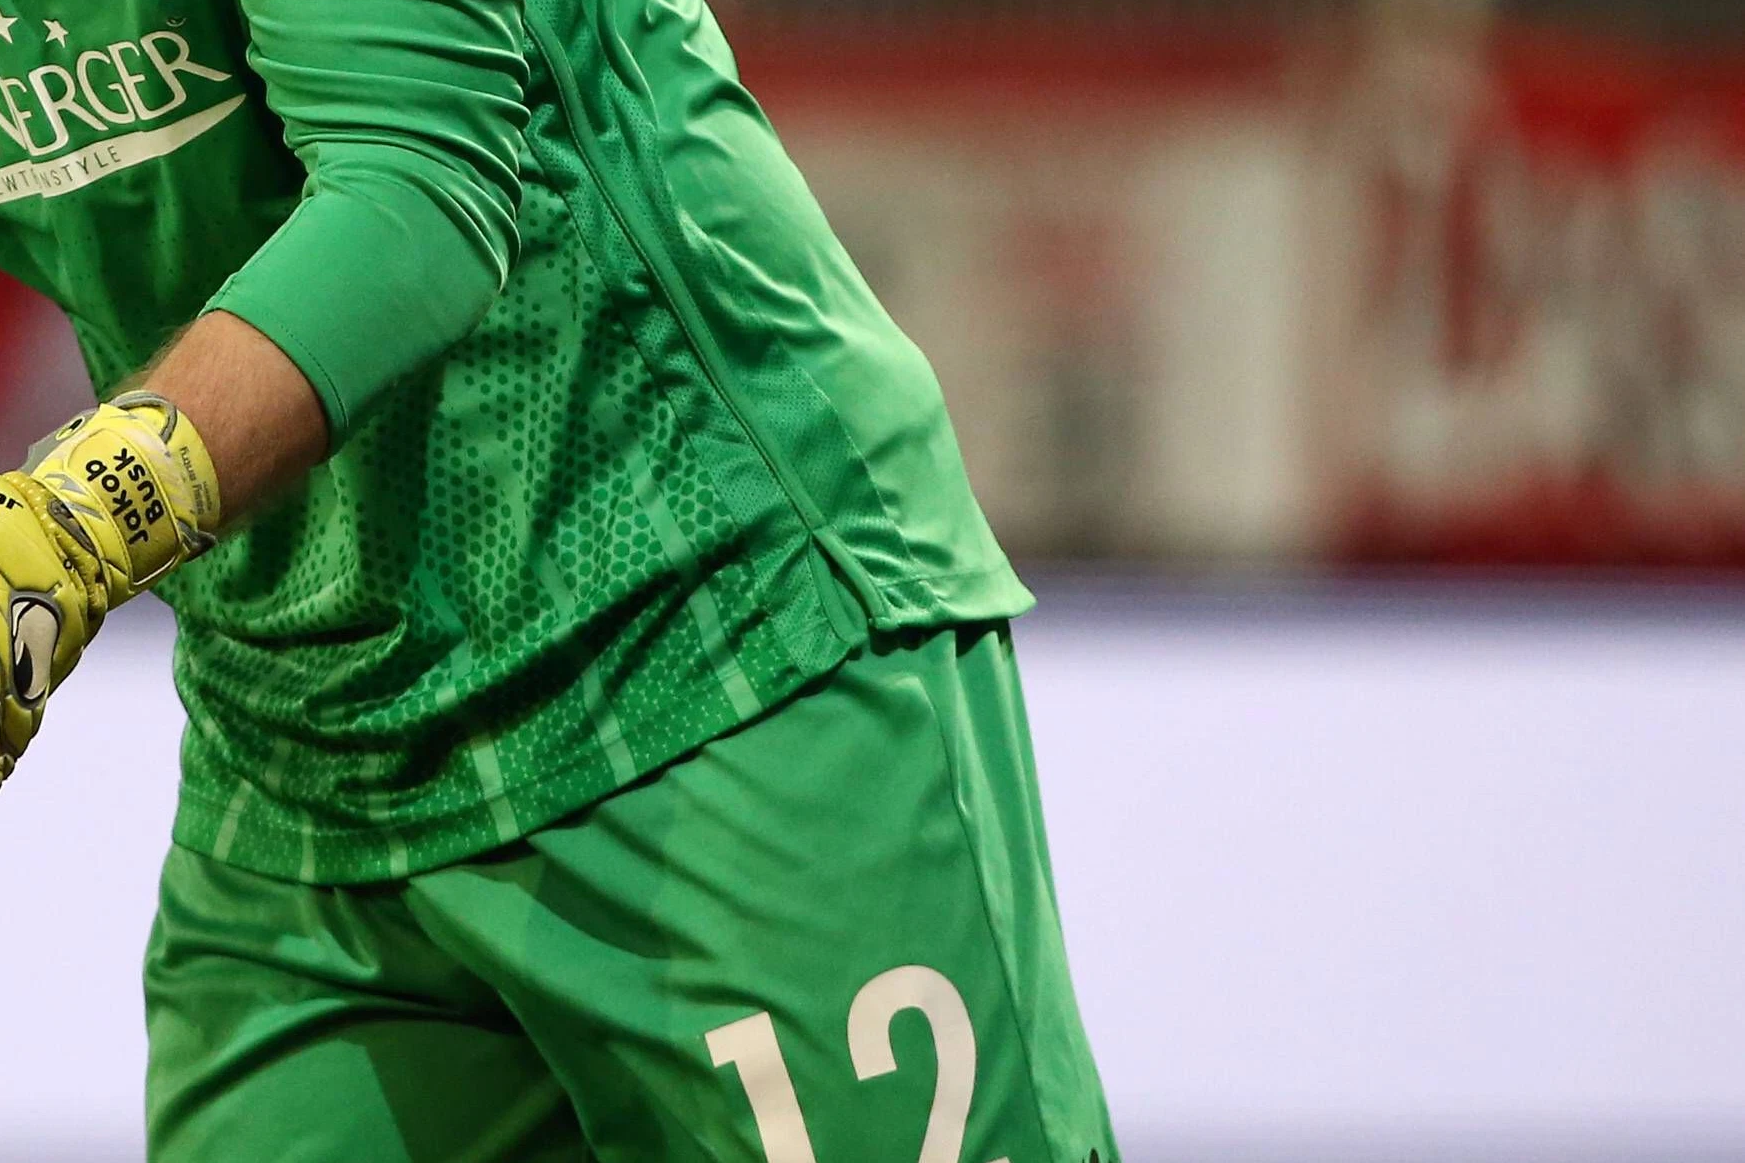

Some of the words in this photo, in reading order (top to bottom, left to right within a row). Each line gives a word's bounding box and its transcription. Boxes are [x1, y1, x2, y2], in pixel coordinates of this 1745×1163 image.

[85, 459, 149, 545] Jakob
[113, 447, 165, 526] Busk
[179, 445, 197, 482] entry
[704, 964, 1012, 1163] 12
